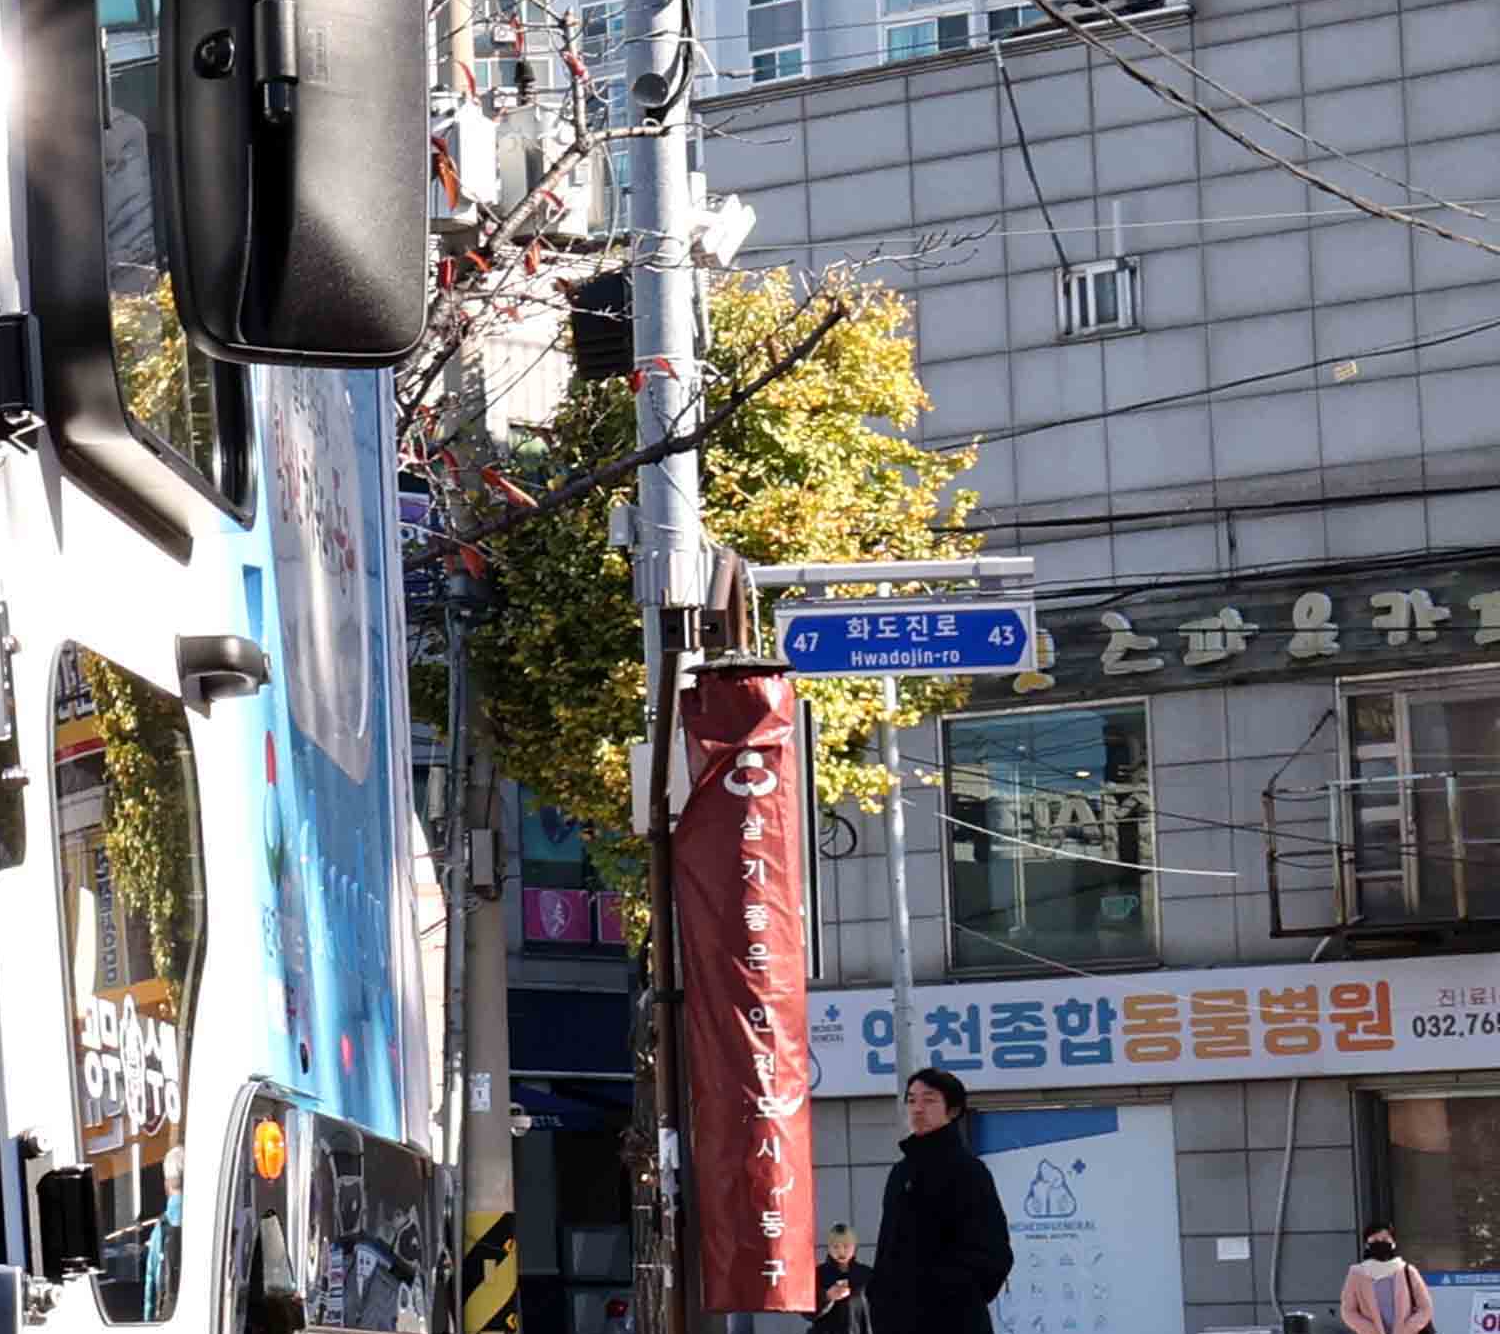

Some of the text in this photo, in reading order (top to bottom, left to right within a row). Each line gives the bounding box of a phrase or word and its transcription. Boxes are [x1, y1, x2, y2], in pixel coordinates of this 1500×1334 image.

[846, 613, 959, 643] 화도진로
[987, 625, 1016, 647] 43
[792, 632, 820, 653] 47
[850, 649, 961, 668] Hwadojin-ro
